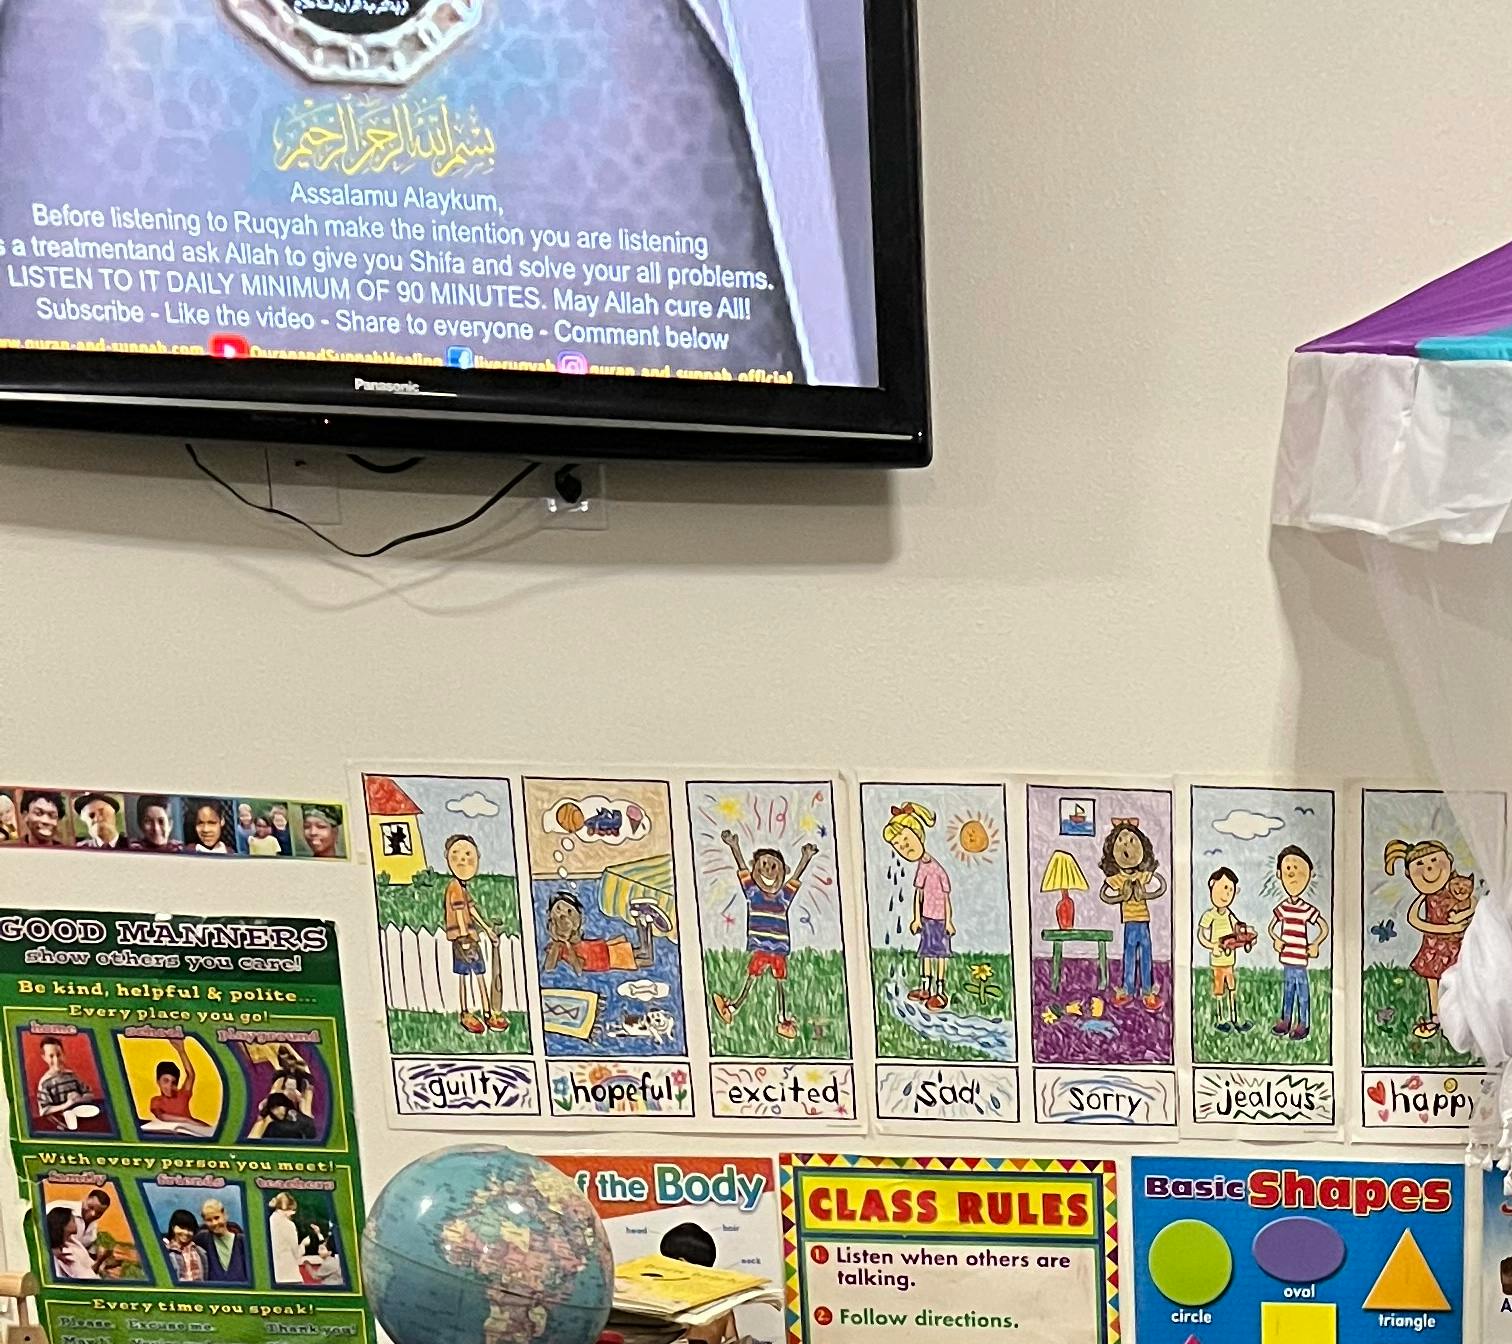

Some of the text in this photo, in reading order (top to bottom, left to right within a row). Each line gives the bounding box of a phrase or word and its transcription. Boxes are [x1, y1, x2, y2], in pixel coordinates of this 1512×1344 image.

[290, 181, 504, 216] Assalamu Alaykum,
[32, 203, 709, 260] Before listening to Ruqyah make the intention you are listening
[7, 264, 752, 321] LISTEN TO IT DAILY MINIMUM OF 90 MINUTES. May Allah cure All!
[354, 377, 421, 393] Panasonic
[0, 916, 328, 951] GOOD MANNERS
[25, 947, 302, 972] show others you care!
[18, 980, 46, 995] Be
[53, 982, 110, 998] kind,
[116, 984, 200, 1001] helpful
[207, 986, 223, 1001] &
[428, 1070, 508, 1109] guilty
[568, 1068, 674, 1107] hopeful
[728, 1074, 840, 1105] excited
[1069, 1085, 1143, 1118] sorry
[1216, 1079, 1317, 1115] jealous
[598, 1165, 764, 1209] the Body
[1145, 1169, 1453, 1216] Basic Shapes
[808, 1187, 1089, 1227] CLASS RULES
[837, 1247, 1070, 1268] Listen when others are
[838, 1270, 916, 1291] talking.
[1283, 1285, 1316, 1299] oval
[840, 1309, 1019, 1329] Follow directions.
[1171, 1309, 1213, 1324] circle
[1378, 1313, 1436, 1332] triangle
